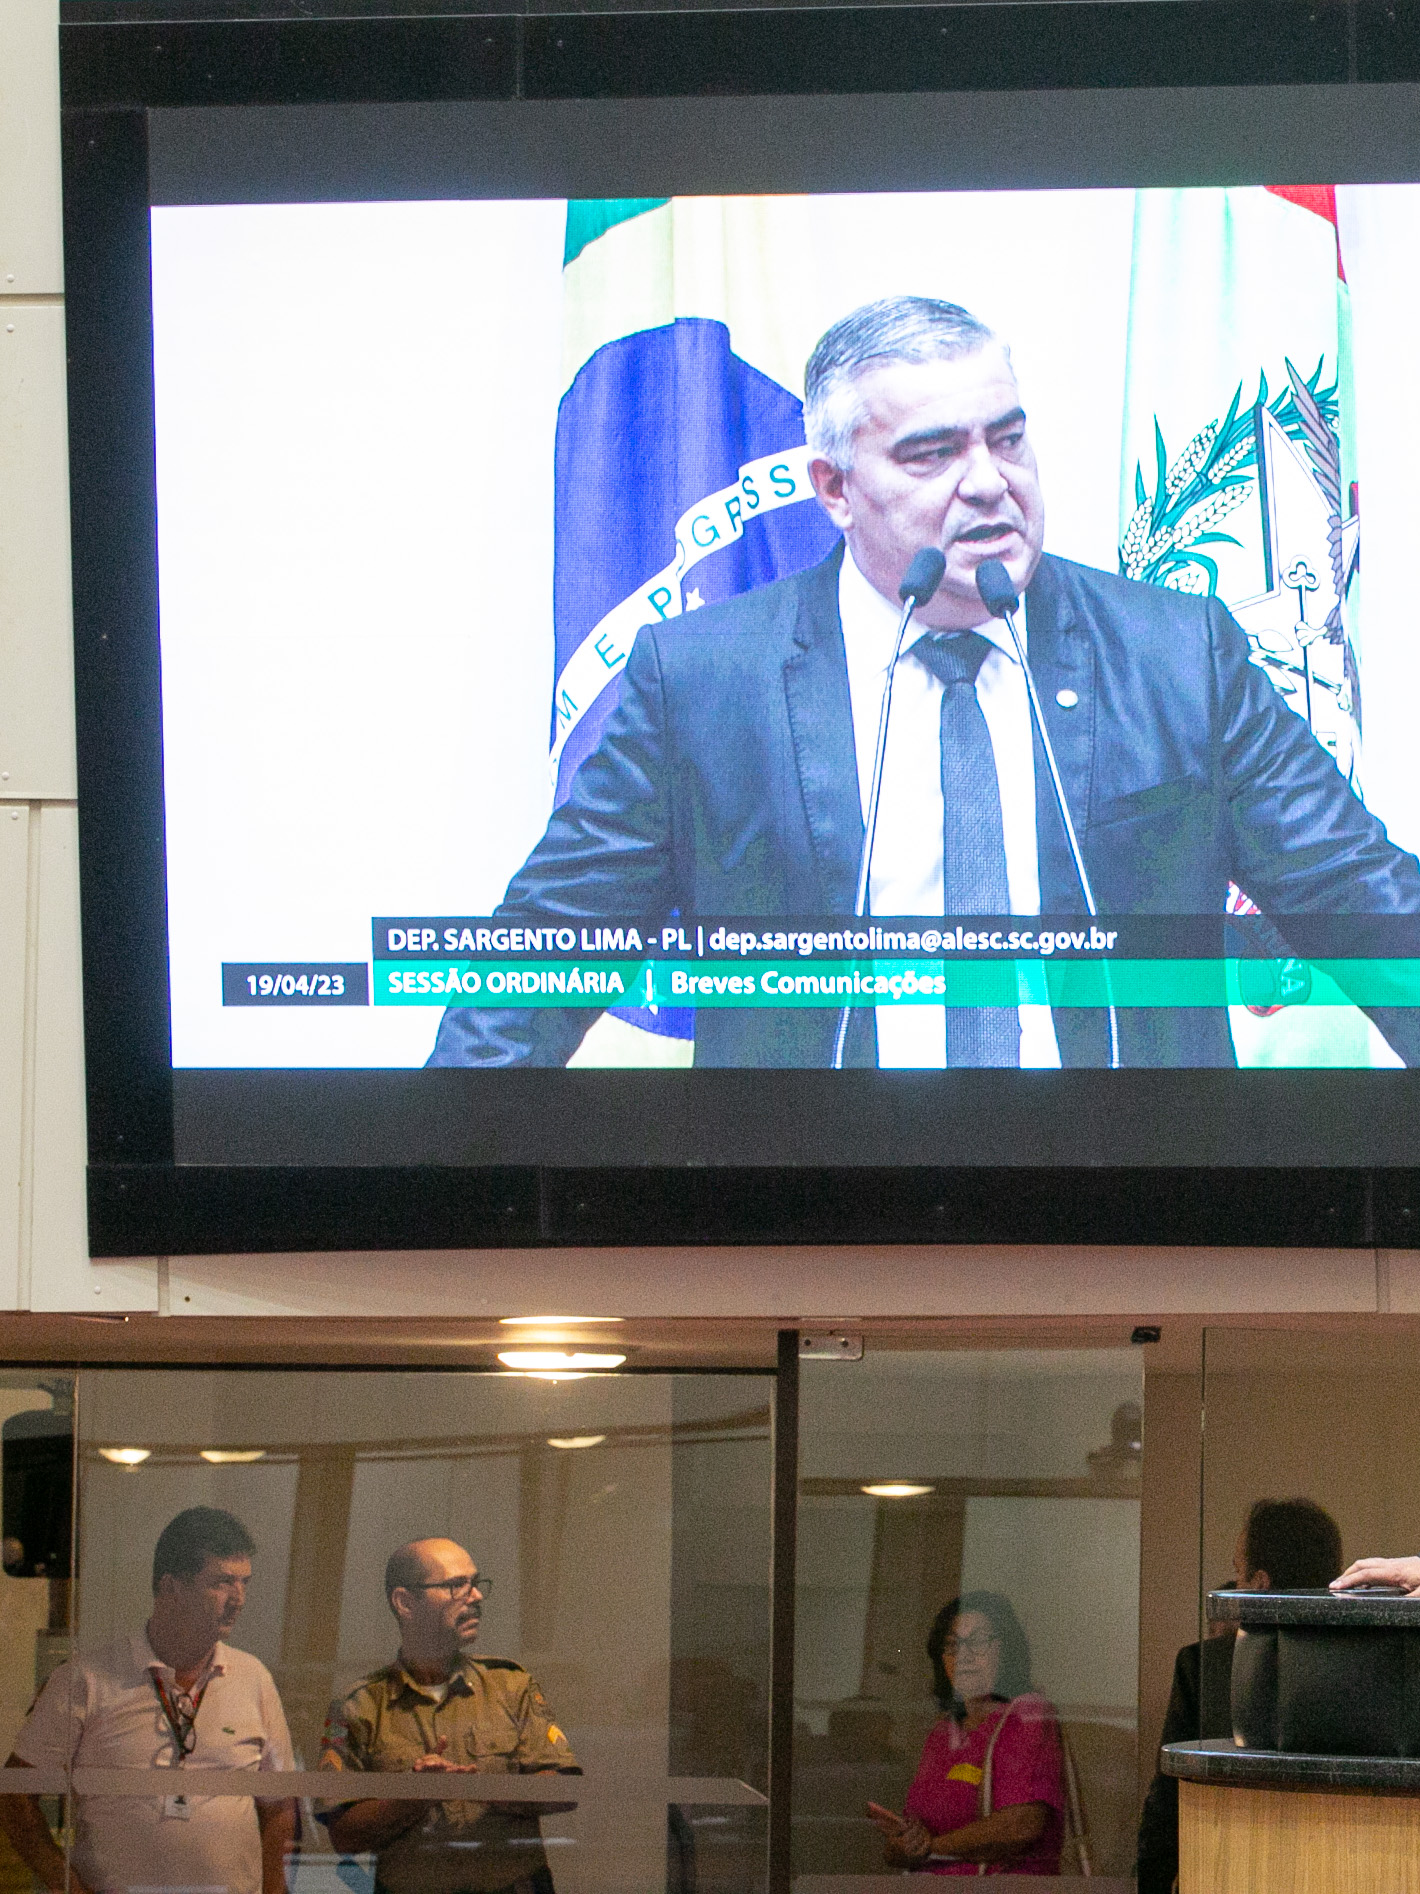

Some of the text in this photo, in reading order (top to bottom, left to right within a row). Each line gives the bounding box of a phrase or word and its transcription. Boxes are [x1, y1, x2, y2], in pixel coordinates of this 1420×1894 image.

[387, 928, 439, 951] DEP.
[443, 928, 577, 951] SARGENTO
[580, 928, 643, 951] LIMA
[661, 928, 692, 951] PL
[708, 926, 1118, 956] dep.sargentolima@alesc.sc.gov.br
[246, 974, 345, 997] 19/04/23
[388, 967, 482, 994] SESSÃO
[485, 966, 625, 994] ORDINÁRIA
[671, 970, 756, 995] Breves
[760, 970, 947, 1000] Comunicações
